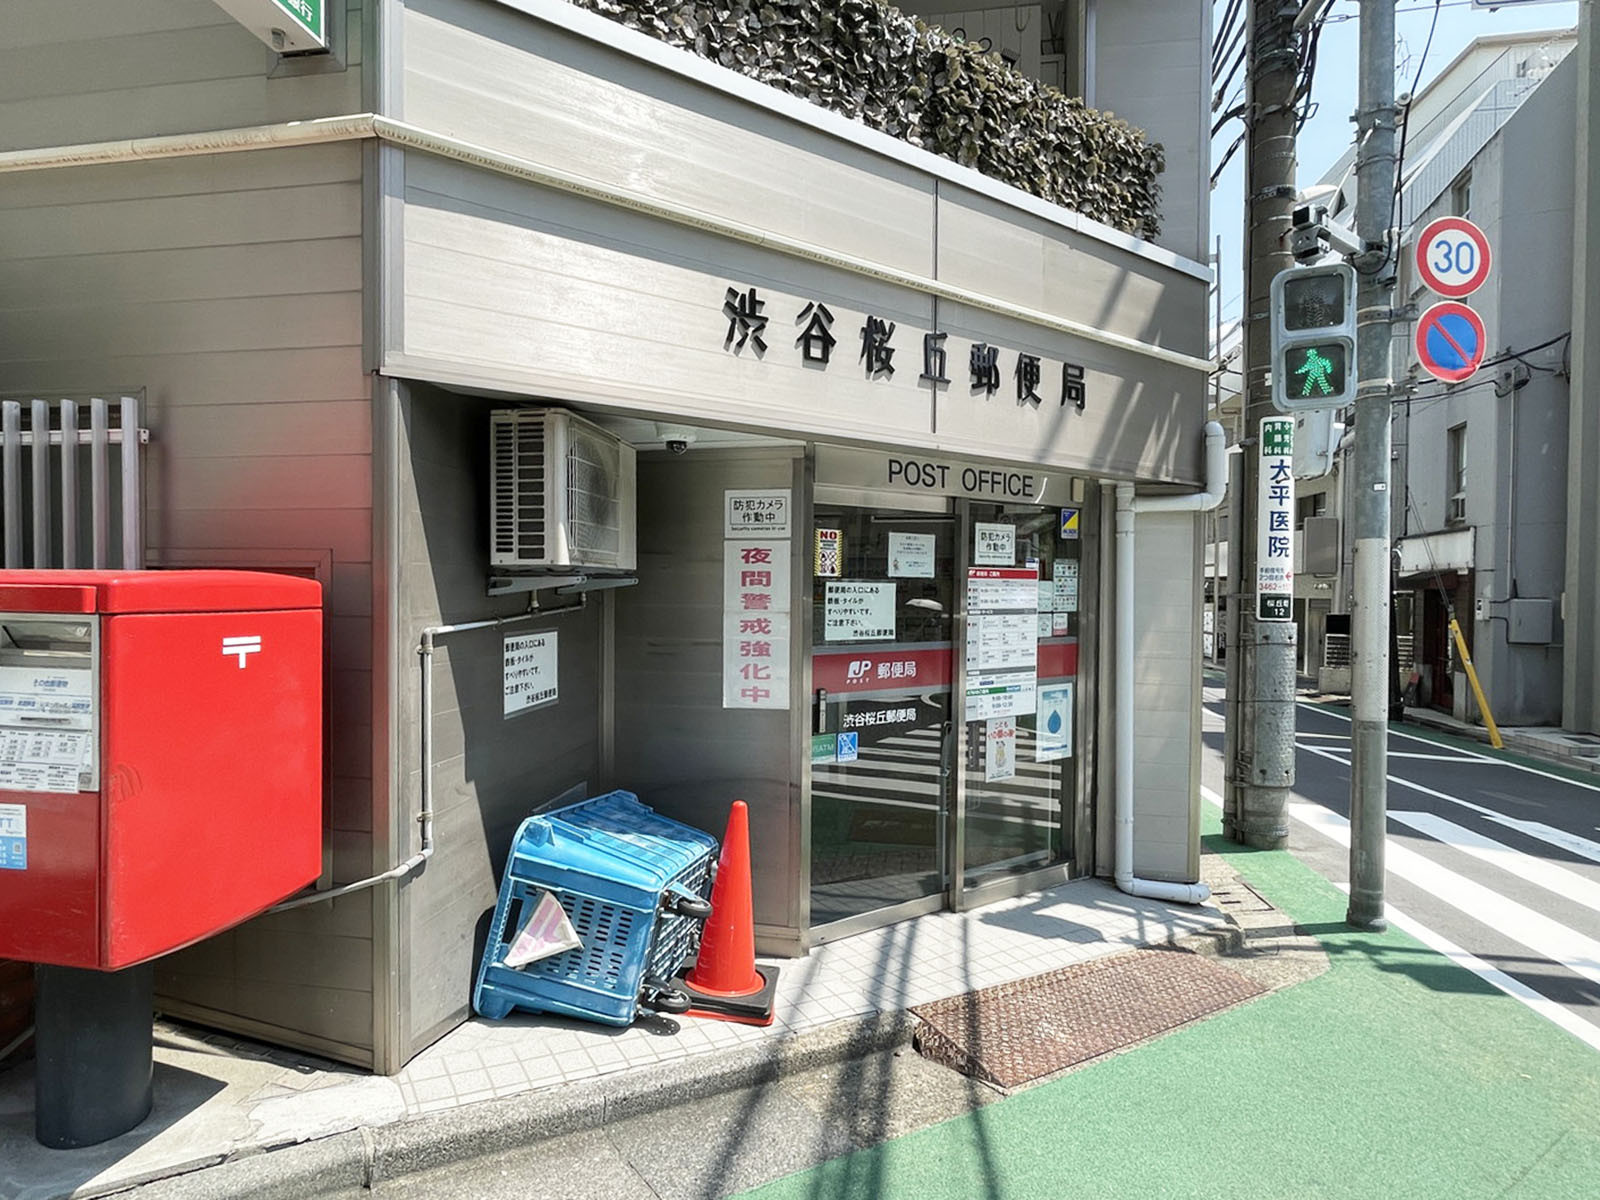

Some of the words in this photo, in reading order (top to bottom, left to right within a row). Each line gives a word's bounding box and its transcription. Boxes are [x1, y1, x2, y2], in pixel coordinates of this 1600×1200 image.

[1434, 239, 1474, 275] 30
[722, 286, 1086, 411] 渋谷桜丘郵便局
[888, 458, 950, 488] POST
[961, 467, 1034, 498] OFFICE
[733, 499, 784, 511] 防犯カメラ
[1267, 458, 1291, 559] 大平医院
[742, 511, 776, 523] 作動中
[819, 530, 838, 540] NO
[986, 542, 1007, 552] 作動中
[1274, 608, 1285, 616] 12
[740, 547, 772, 703] 夜間警戒強化中
[877, 660, 917, 679] 郵便局
[842, 707, 917, 728] 渋谷桜丘郵便局
